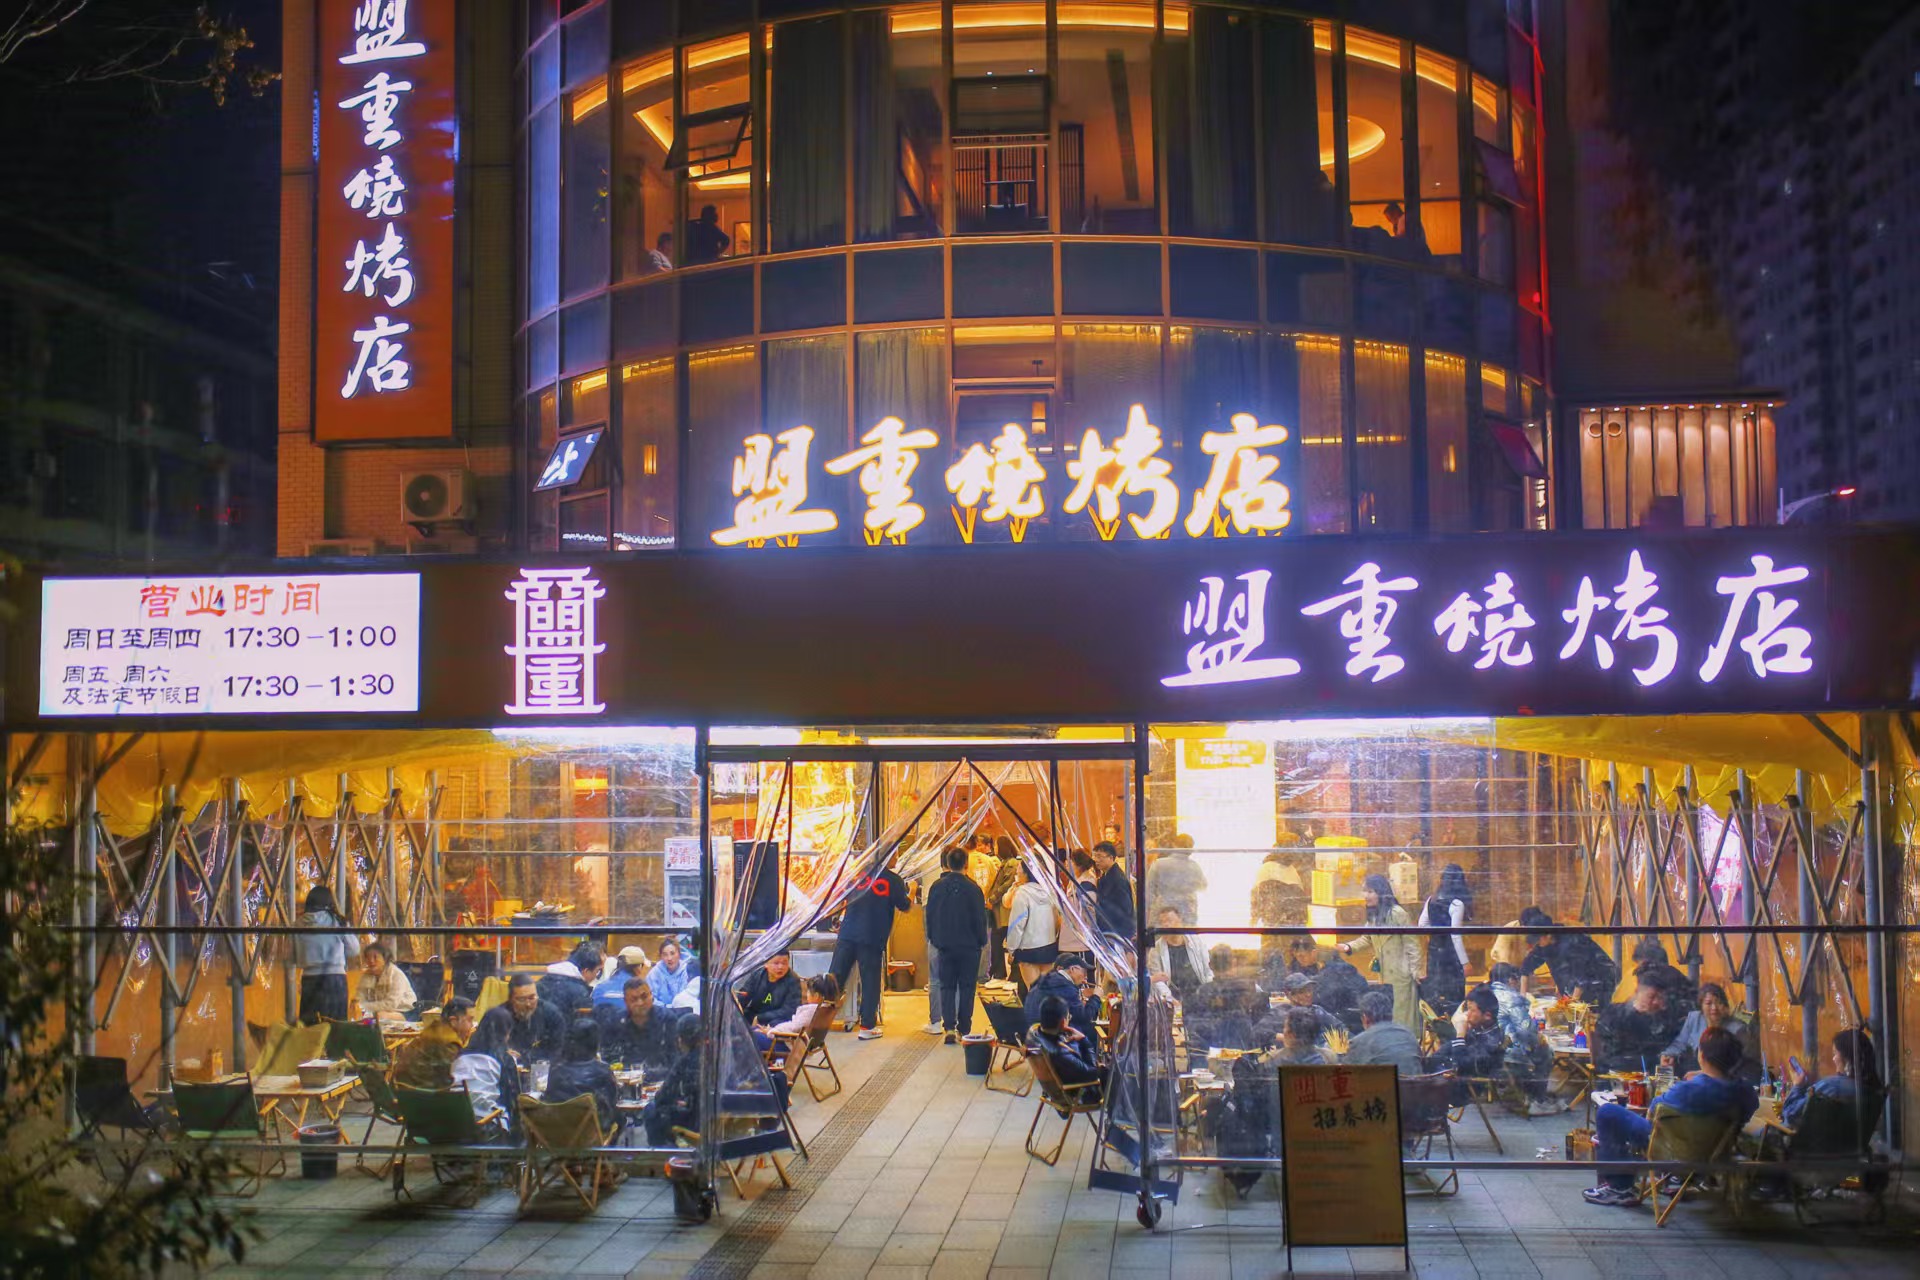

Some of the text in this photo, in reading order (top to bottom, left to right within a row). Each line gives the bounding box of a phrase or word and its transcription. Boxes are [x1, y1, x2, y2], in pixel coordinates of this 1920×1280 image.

[338, 0, 427, 398] 盟重燒烤店
[711, 404, 1292, 544] 盟重燒烤店
[140, 583, 320, 618] 营业时间
[1160, 550, 1813, 687] 盟重燒烤店
[63, 627, 201, 650] 周日至周四
[62, 686, 200, 706] 及法定节假日
[1295, 1066, 1352, 1104] 盟重
